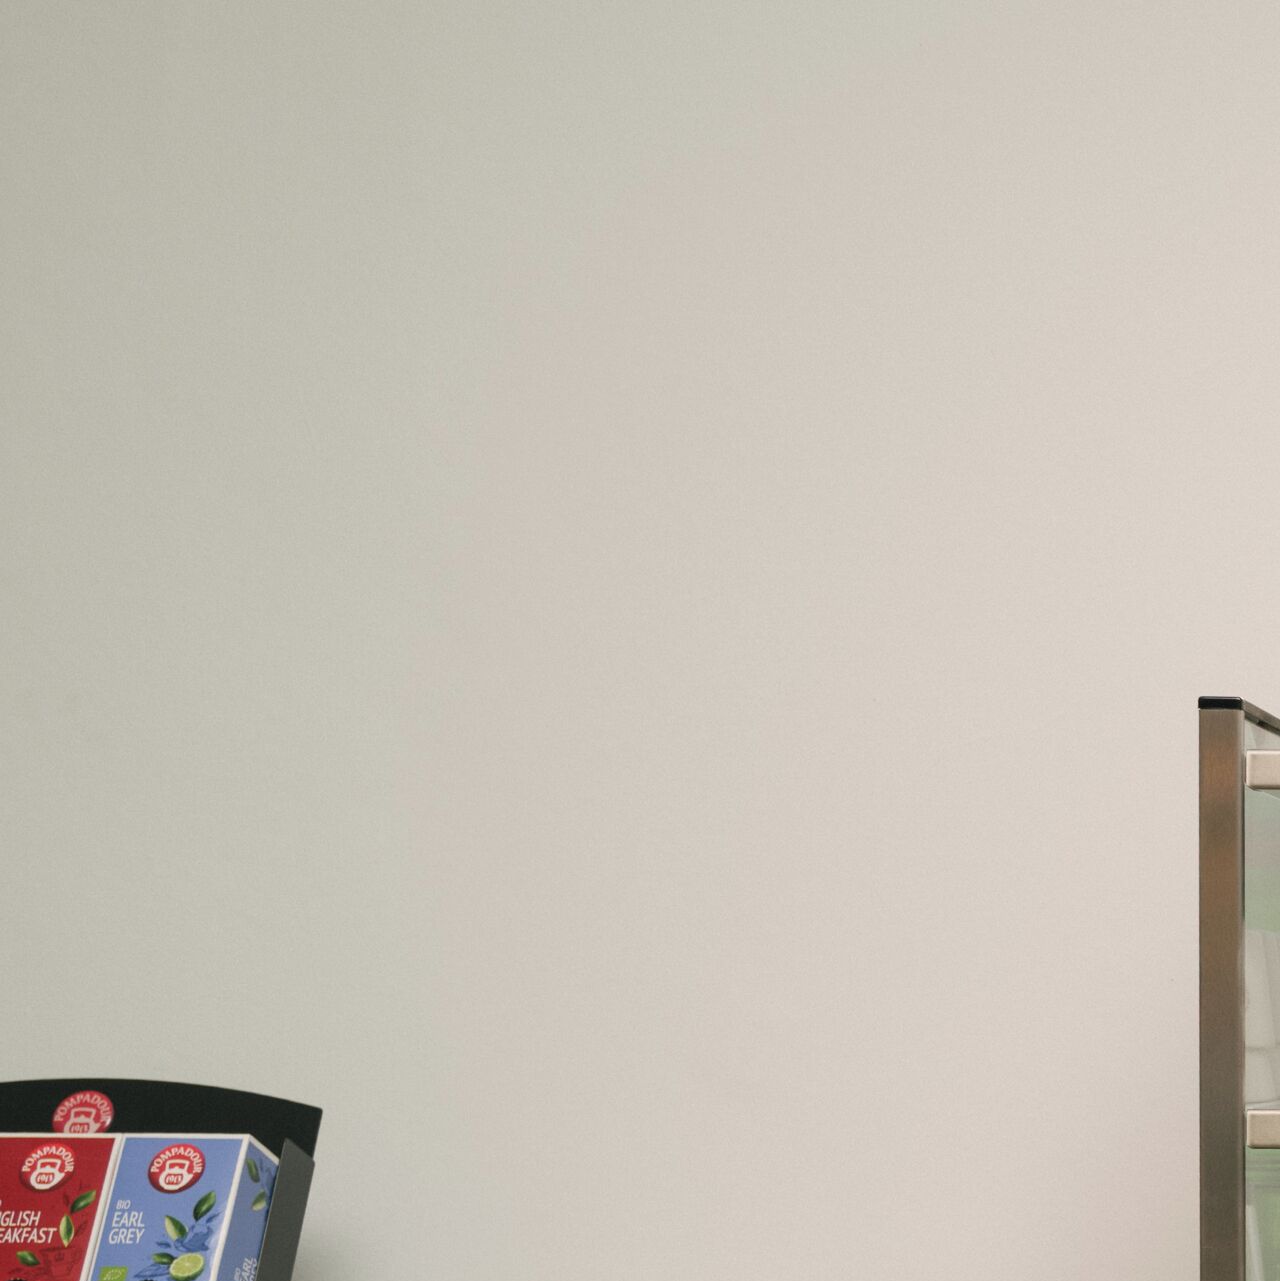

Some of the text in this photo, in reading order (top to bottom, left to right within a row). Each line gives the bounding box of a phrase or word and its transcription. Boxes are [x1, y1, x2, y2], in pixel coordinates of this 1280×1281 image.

[54, 1094, 112, 1122] POMPADOUR
[22, 1145, 75, 1173] POMPADOUR
[150, 1146, 204, 1173] POMPADOUR
[116, 1200, 131, 1210] BIO
[0, 1211, 41, 1227] GLISH
[112, 1211, 145, 1227] EARL
[0, 1228, 57, 1244] EAKFAST
[108, 1228, 145, 1245] GREY
